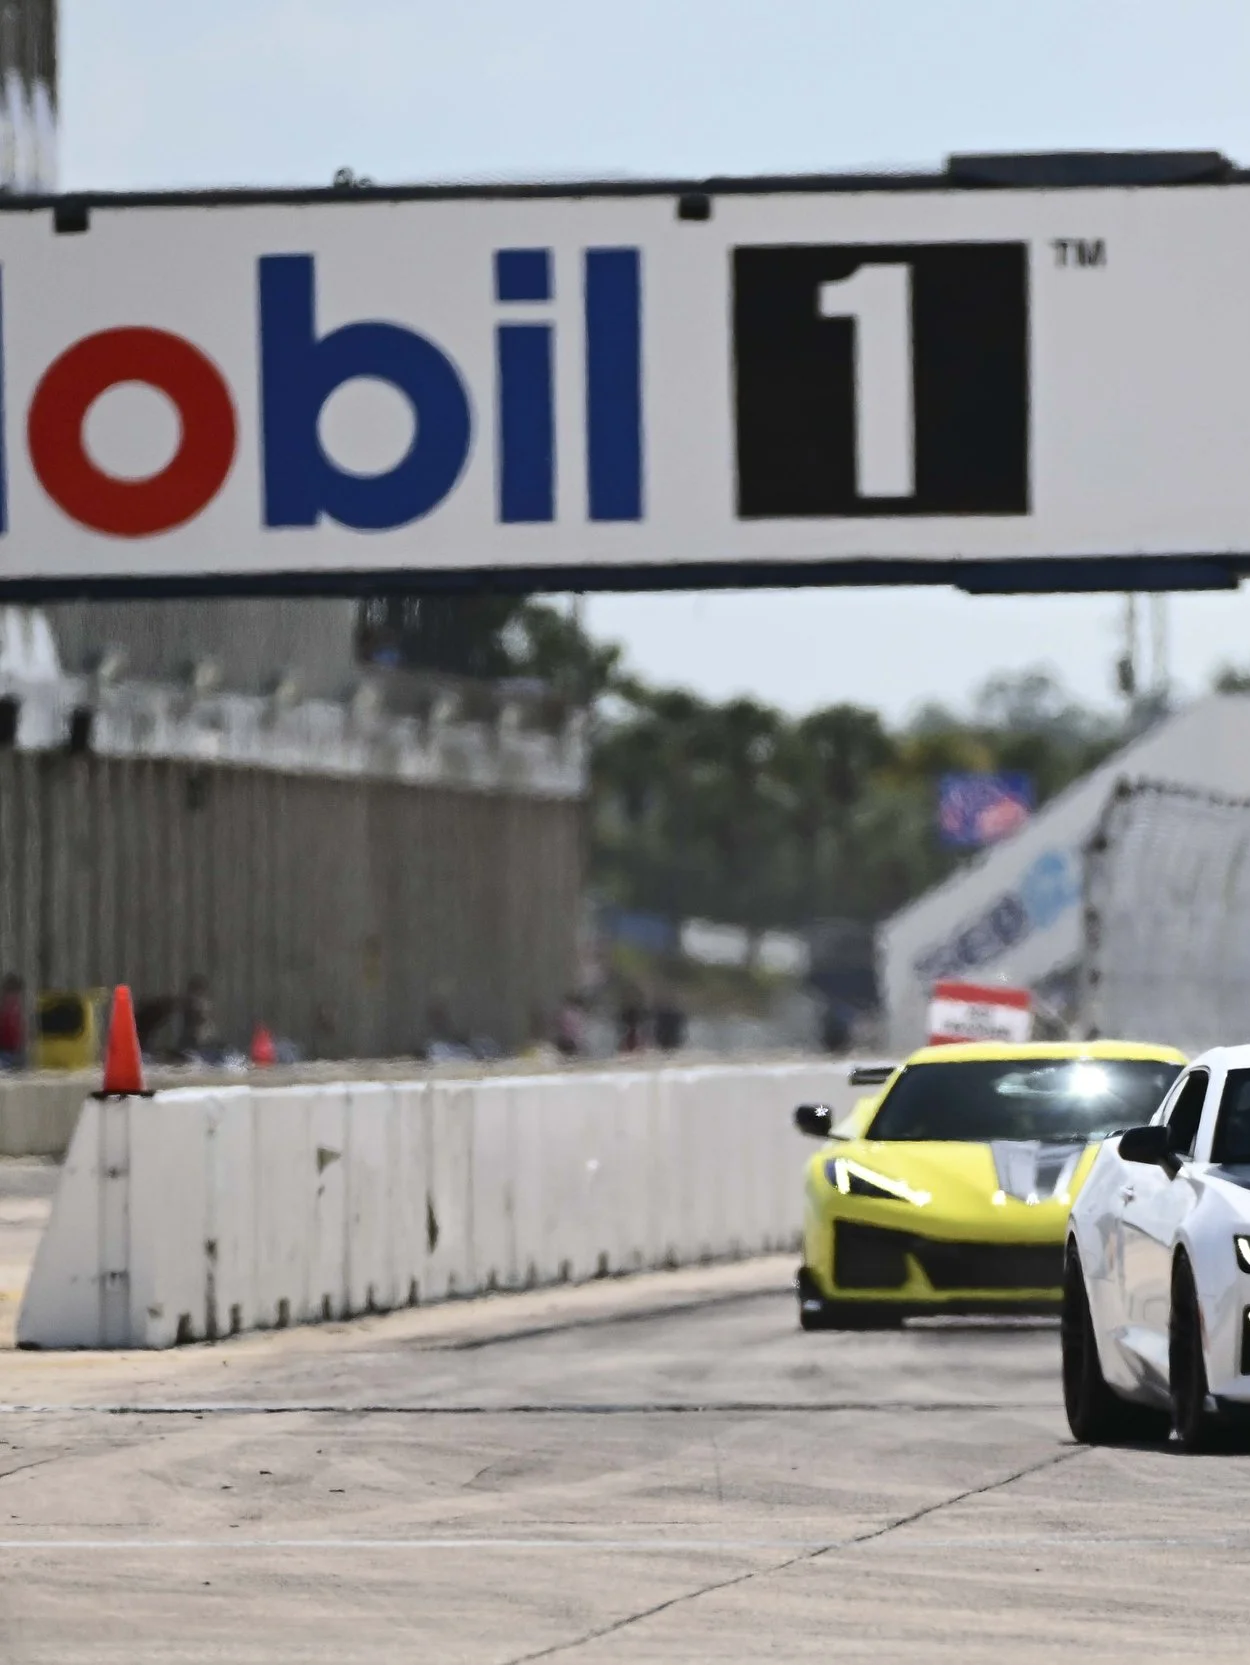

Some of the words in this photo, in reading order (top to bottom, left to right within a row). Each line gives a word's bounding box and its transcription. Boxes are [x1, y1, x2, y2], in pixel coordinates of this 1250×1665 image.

[0, 246, 646, 538] obil
[817, 262, 914, 498] 1
[1052, 238, 1107, 266] TM
